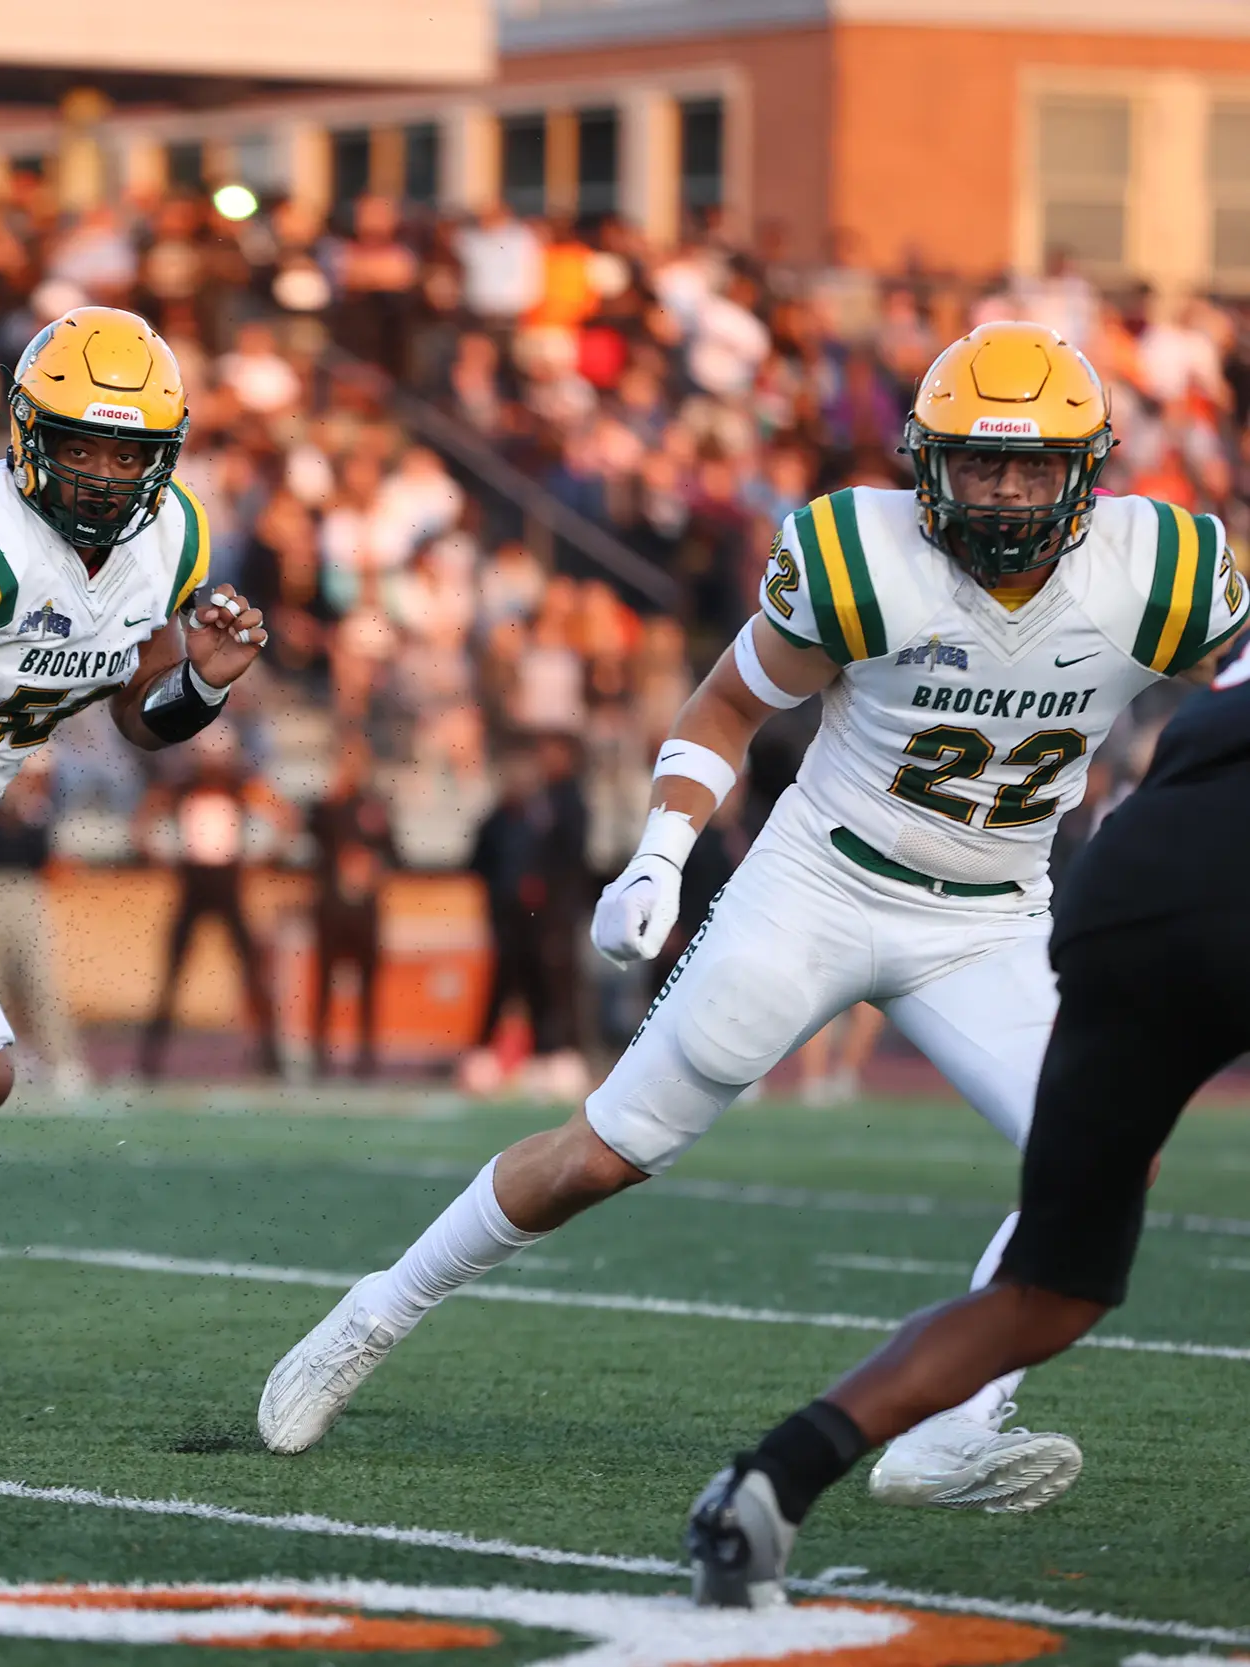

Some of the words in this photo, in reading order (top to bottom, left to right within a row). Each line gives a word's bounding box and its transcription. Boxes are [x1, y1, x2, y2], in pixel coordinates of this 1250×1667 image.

[980, 420, 1031, 433] Riddell
[911, 685, 1097, 719] BROCKPORT
[886, 724, 1088, 829] 22
